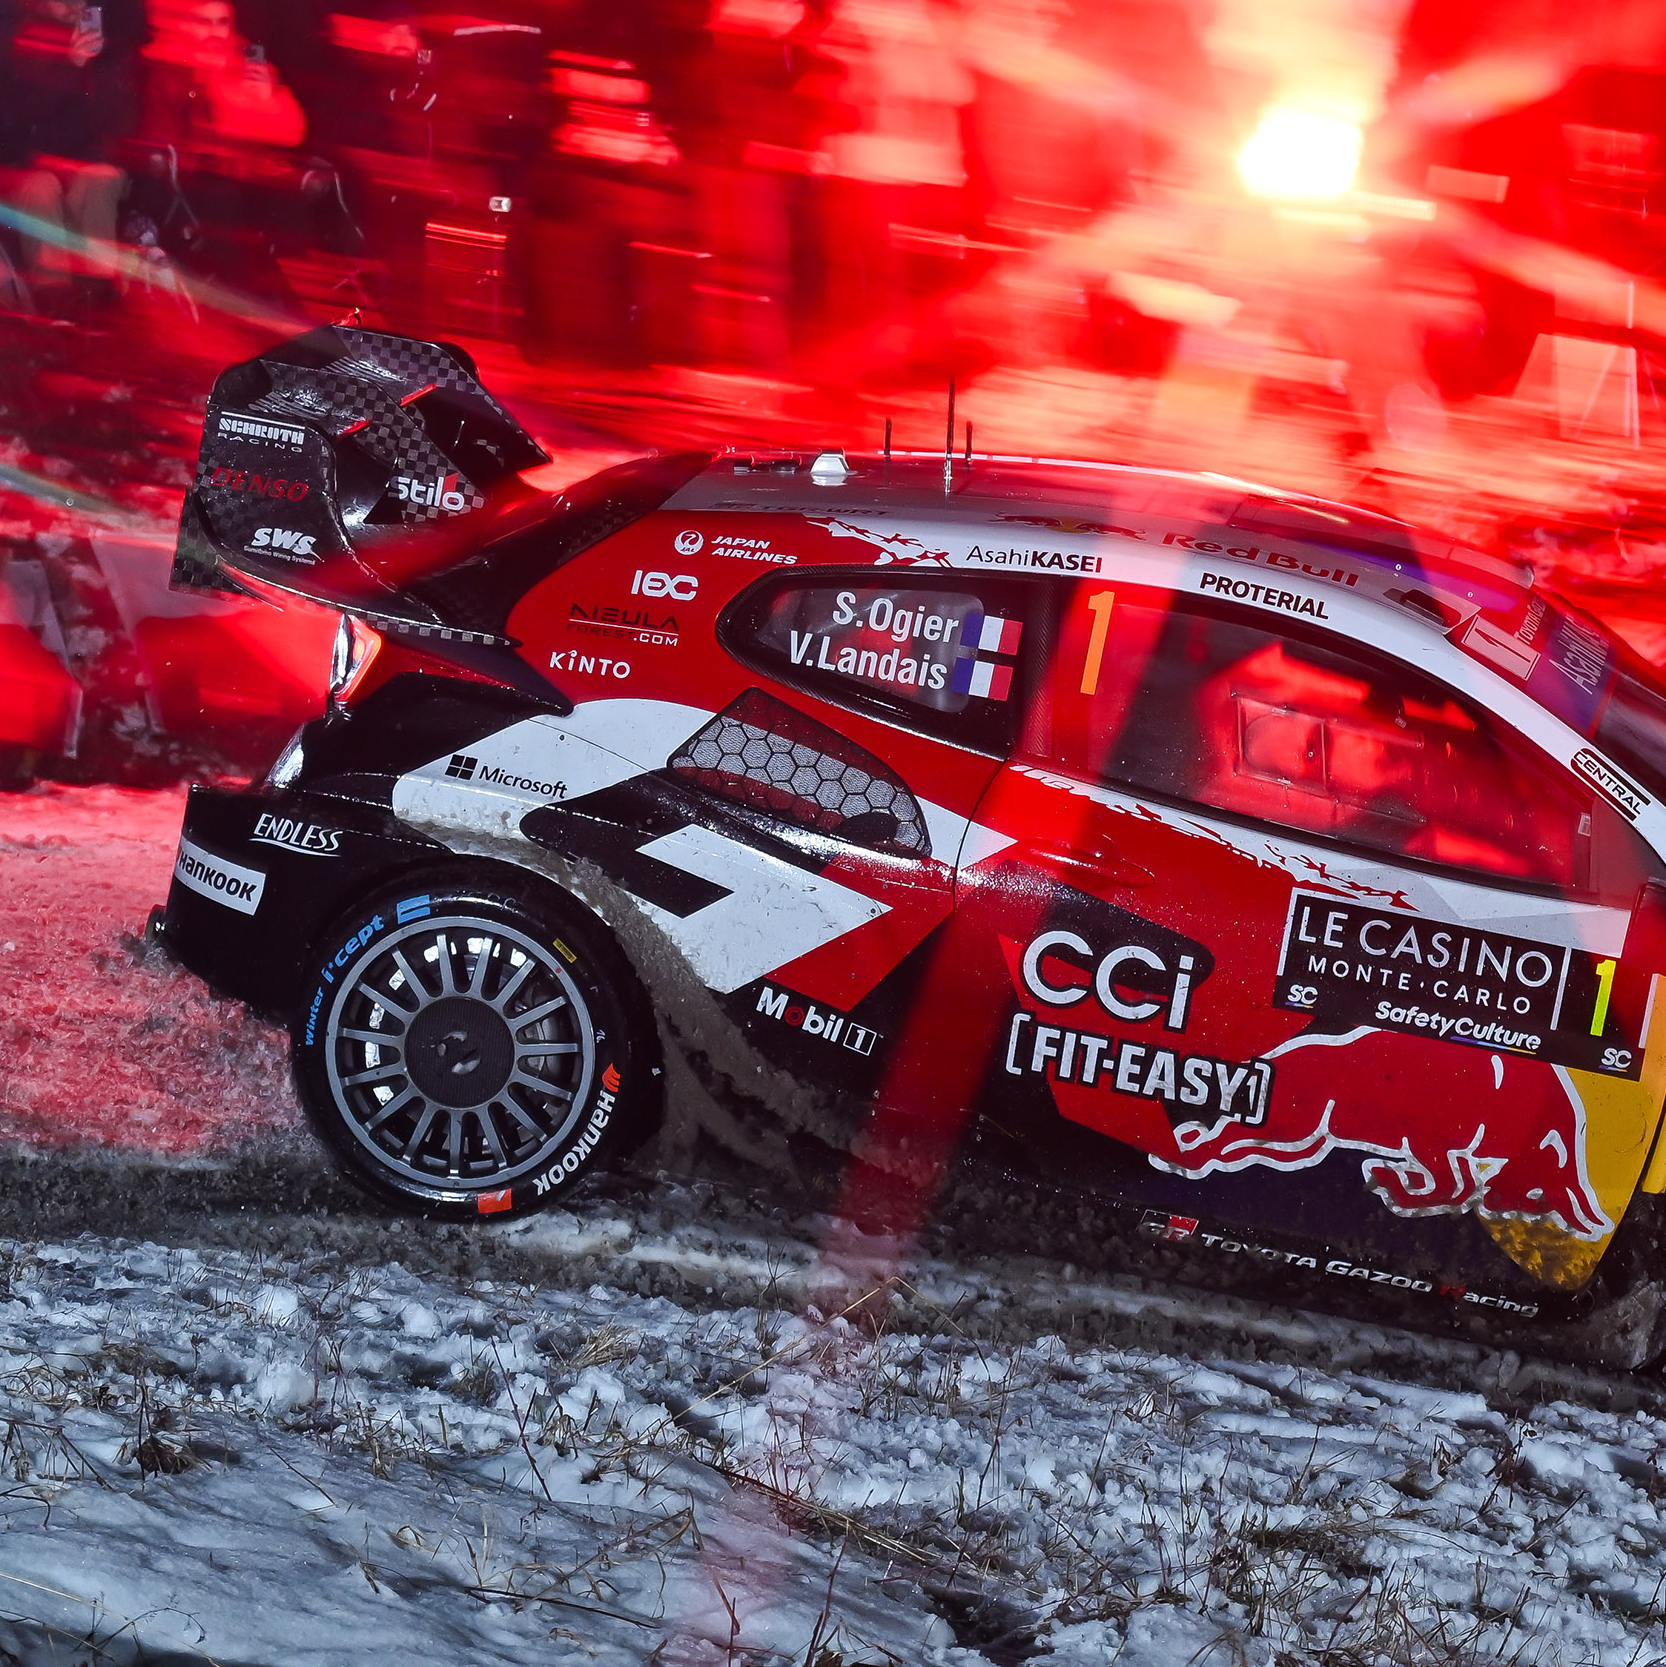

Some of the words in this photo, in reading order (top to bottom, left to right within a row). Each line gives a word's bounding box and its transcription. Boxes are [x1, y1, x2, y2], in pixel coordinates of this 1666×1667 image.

[217, 432, 302, 453] RACING
[219, 417, 305, 445] SCHROTH
[211, 466, 309, 502] DENSO
[388, 476, 465, 511] Stilo
[251, 527, 317, 555] SWS
[711, 536, 771, 550] JAPAN
[711, 547, 798, 565] AIRLINES
[1162, 532, 1261, 560] Red
[1266, 551, 1359, 587] Bull
[1199, 572, 1329, 620] PROTERIAL
[1080, 590, 1116, 696] 1
[478, 765, 568, 799] Microsoft
[1573, 751, 1641, 815] CENTRAL
[253, 813, 343, 851] ENDLESS
[1298, 906, 1349, 949] LE
[1359, 919, 1553, 987] CASINO
[1286, 984, 1319, 1005] SC
[1590, 959, 1617, 1037] 1
[756, 986, 844, 1043] Mobil
[854, 1029, 867, 1049] 1
[1600, 1047, 1632, 1069] SC
[1201, 1233, 1317, 1269] TOYOTA
[1325, 1260, 1433, 1293] GAZOO
